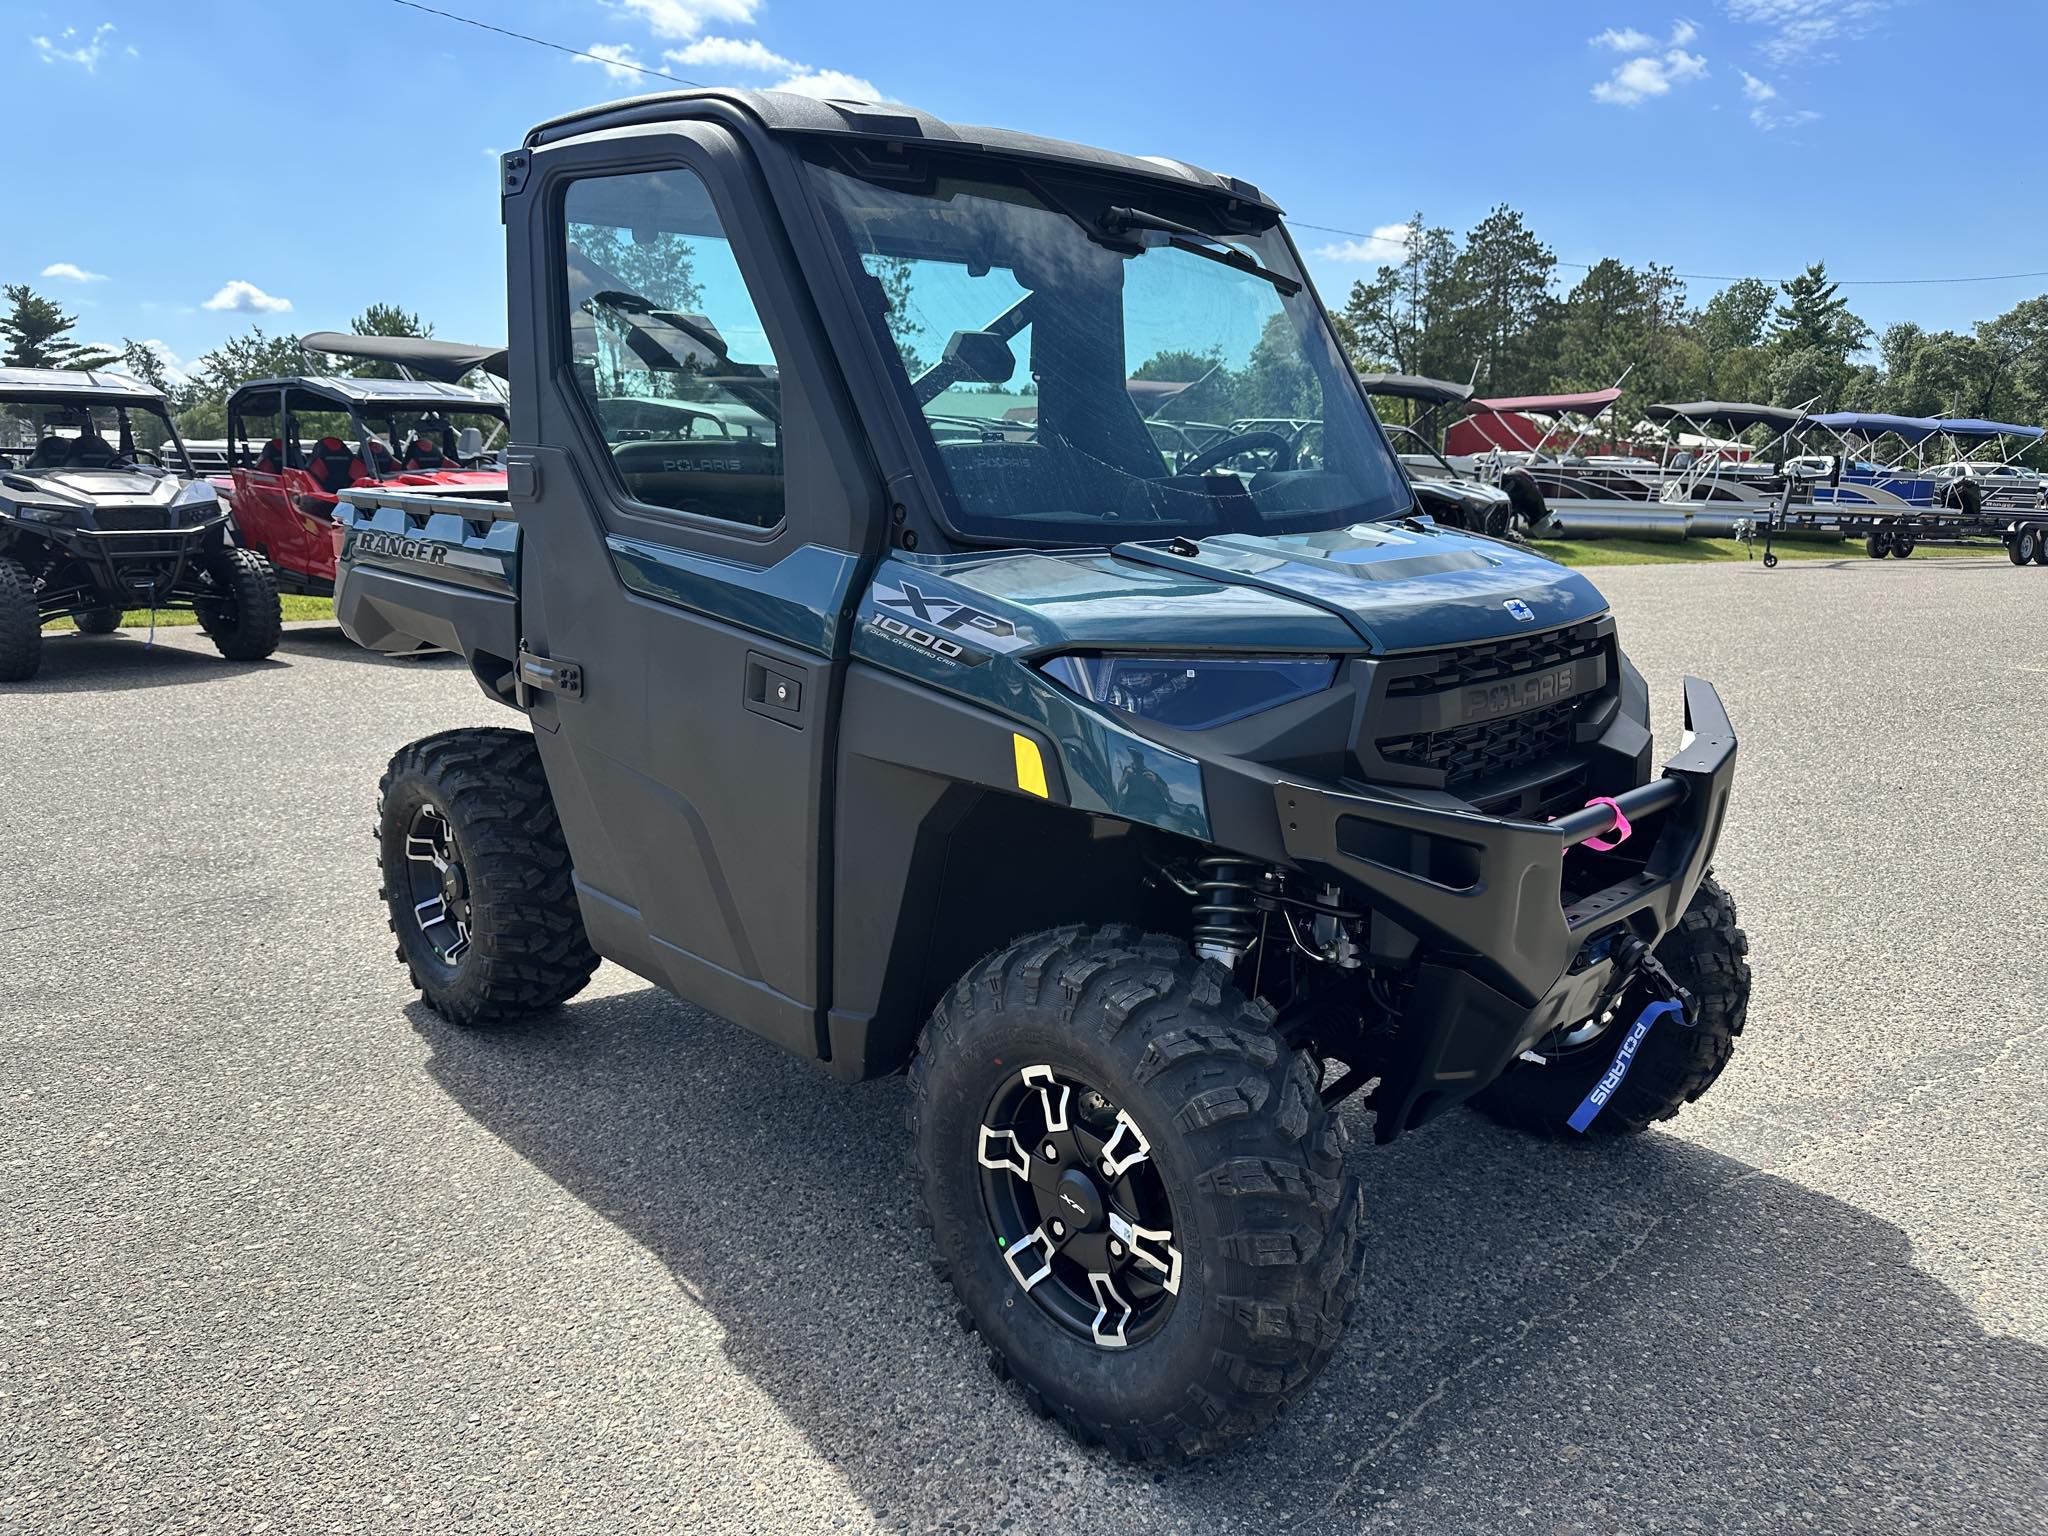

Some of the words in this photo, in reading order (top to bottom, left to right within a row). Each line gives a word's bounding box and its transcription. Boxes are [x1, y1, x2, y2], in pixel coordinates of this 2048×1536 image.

[663, 459, 741, 472] POLARIS
[358, 531, 449, 567] RANGER
[874, 580, 1018, 638] XP
[870, 629, 890, 641] DUAL
[892, 638, 936, 659] OVERHEAD
[936, 656, 957, 667] CAM
[872, 613, 963, 658] 1000
[1465, 667, 1573, 718] POLARIS
[1590, 1022, 1647, 1106] POLARIS
[1059, 1193, 1086, 1215] XP
